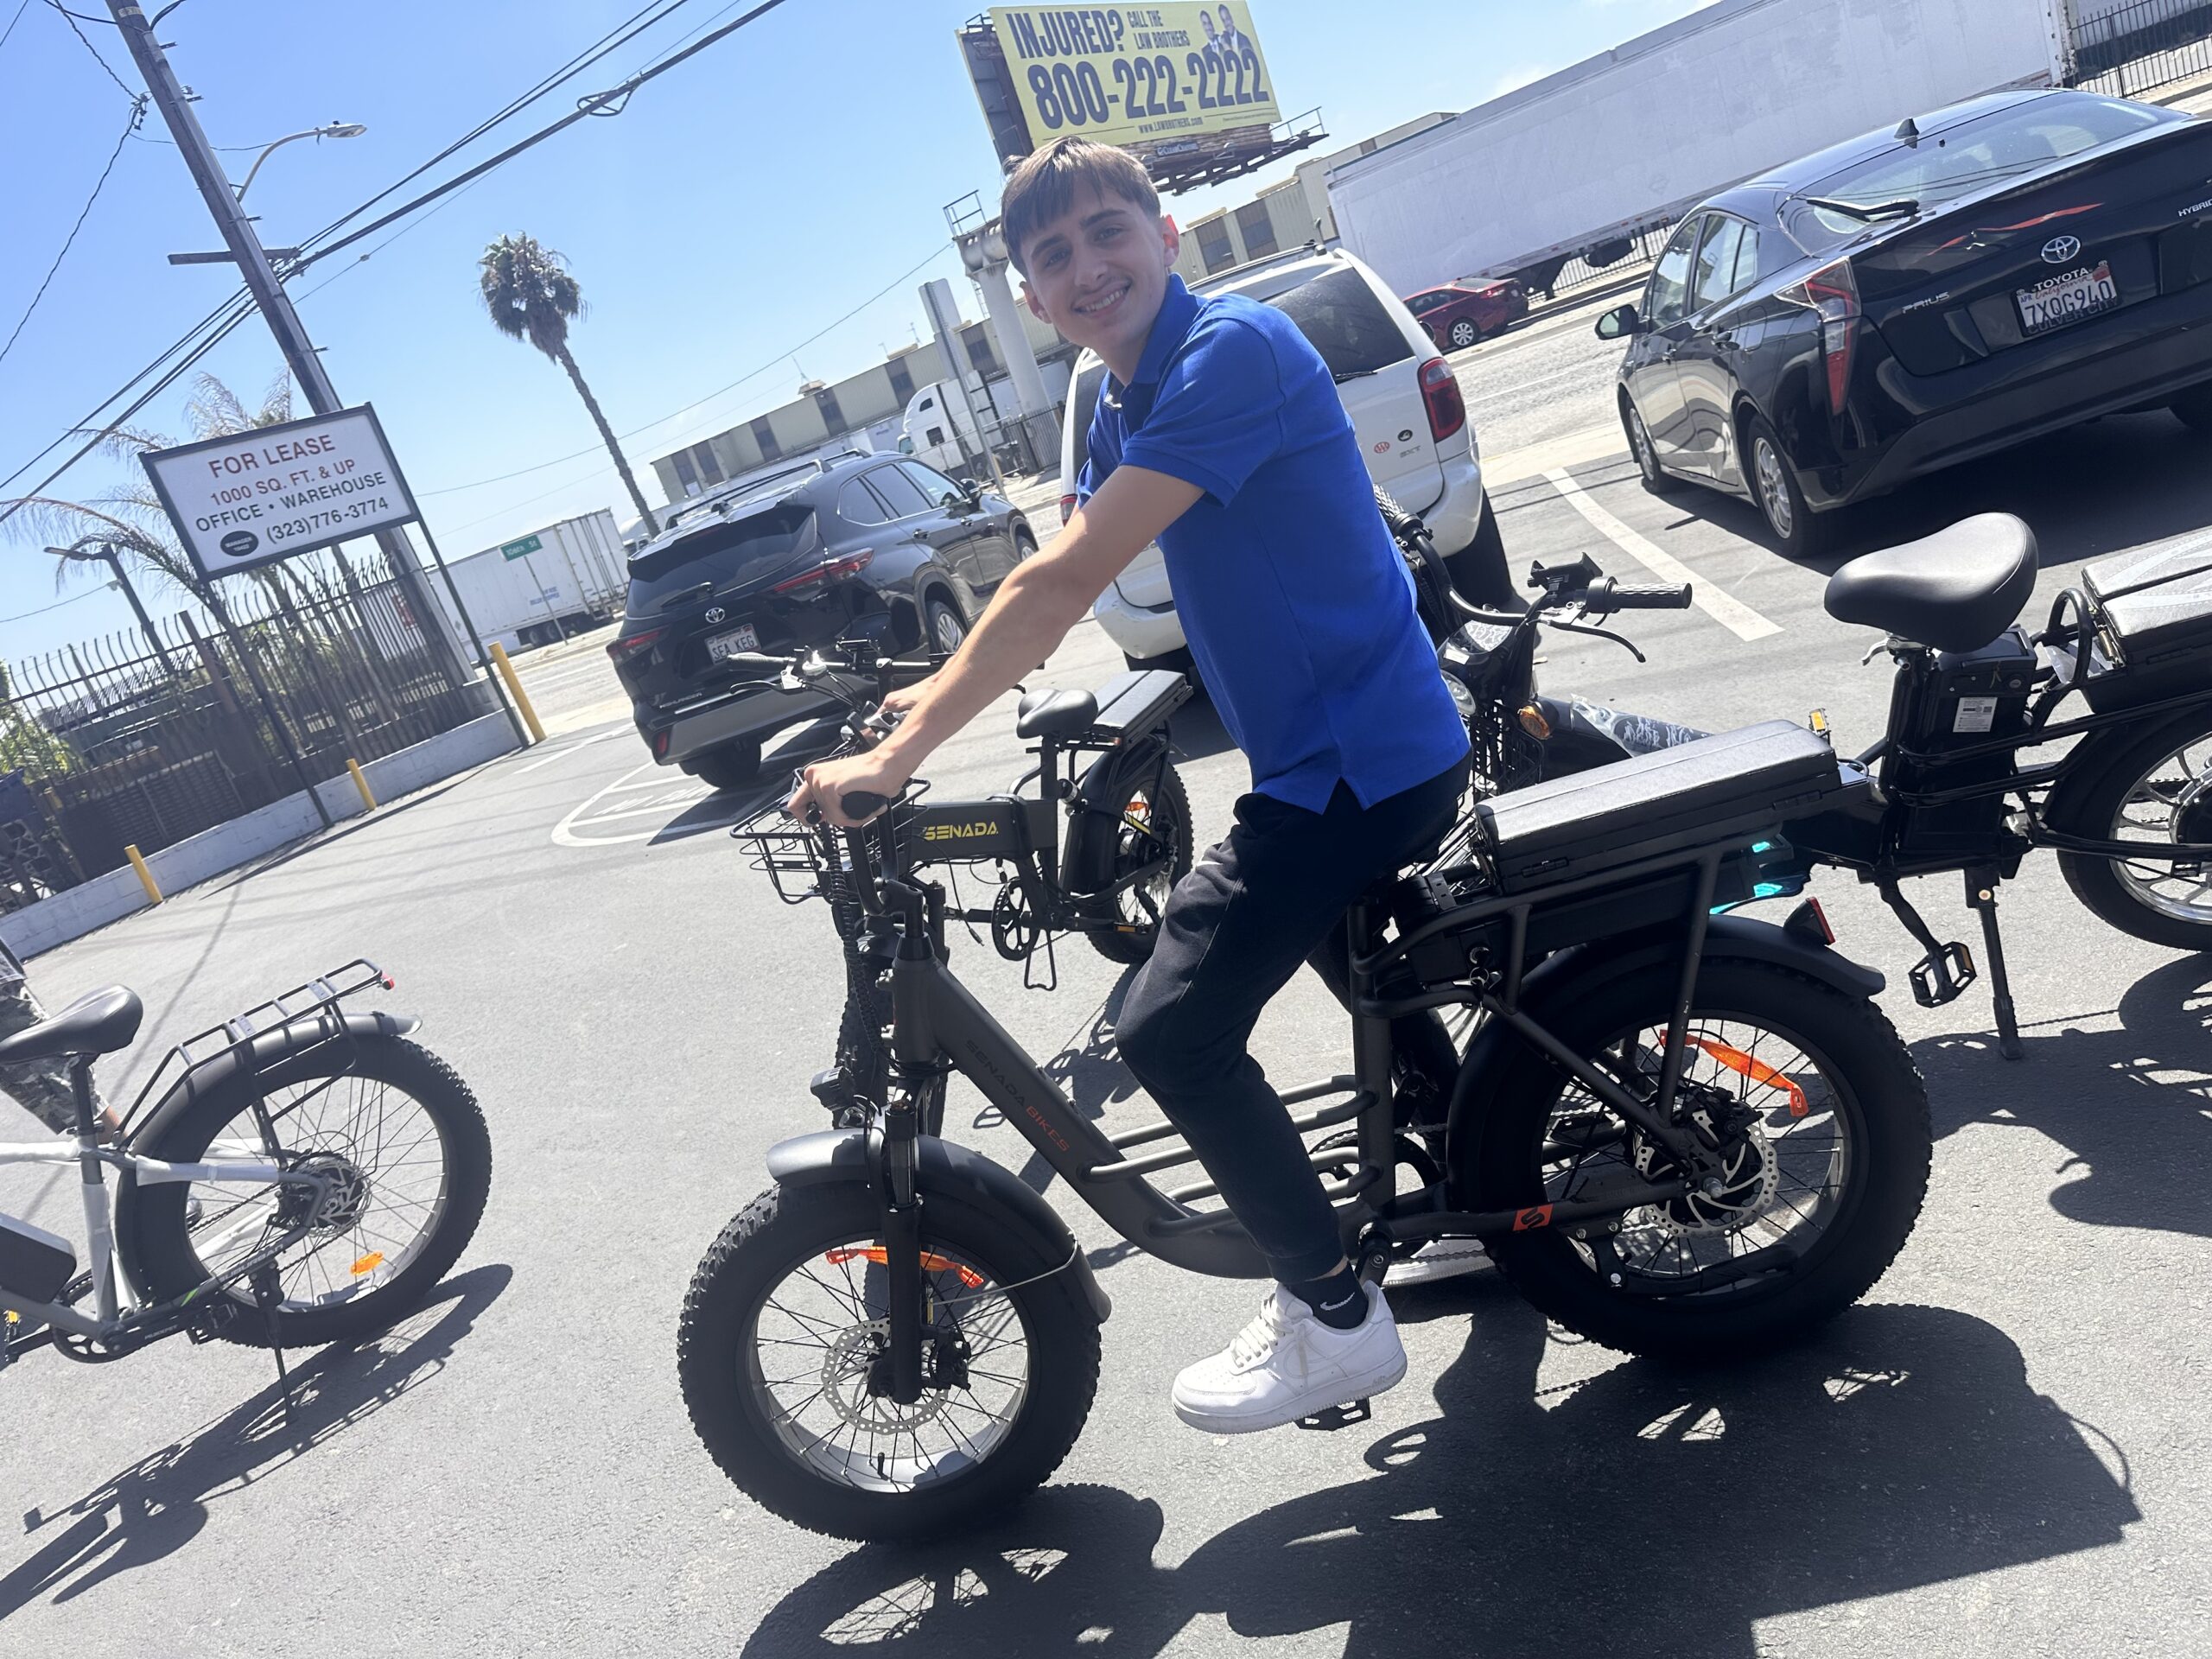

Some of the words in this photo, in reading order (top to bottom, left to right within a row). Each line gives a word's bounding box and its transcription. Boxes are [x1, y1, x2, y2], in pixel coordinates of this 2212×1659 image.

[1005, 9, 1125, 59] INJURED?
[1127, 10, 1148, 28] CALL
[1146, 10, 1164, 27] THE
[1133, 31, 1153, 49] LAW
[1151, 29, 1191, 48] BROTHERS
[1027, 48, 1270, 130] 800-222-2222
[2034, 267, 2089, 291] TOYOTA
[2035, 276, 2091, 300] California
[1902, 292, 1950, 314] PRIUS
[2020, 294, 2033, 304] APR
[2024, 280, 2113, 326] 7XQG940
[2027, 309, 2084, 334] CULVER
[2088, 298, 2118, 315] CITY
[208, 452, 259, 478] FOR
[263, 435, 336, 466] LEASE
[210, 485, 252, 506] 1000
[256, 478, 287, 495] SQ.
[289, 470, 315, 486] FT.
[318, 466, 331, 479] &
[333, 459, 355, 476] UP
[195, 504, 264, 531] OFFICE
[279, 472, 387, 510] WAREHOUSE
[266, 497, 389, 544] (323)776-3774
[712, 643, 732, 659] SEA
[924, 821, 999, 842] SENADA
[964, 1039, 1027, 1107] SENADA
[1026, 1105, 1071, 1153] BIKES
